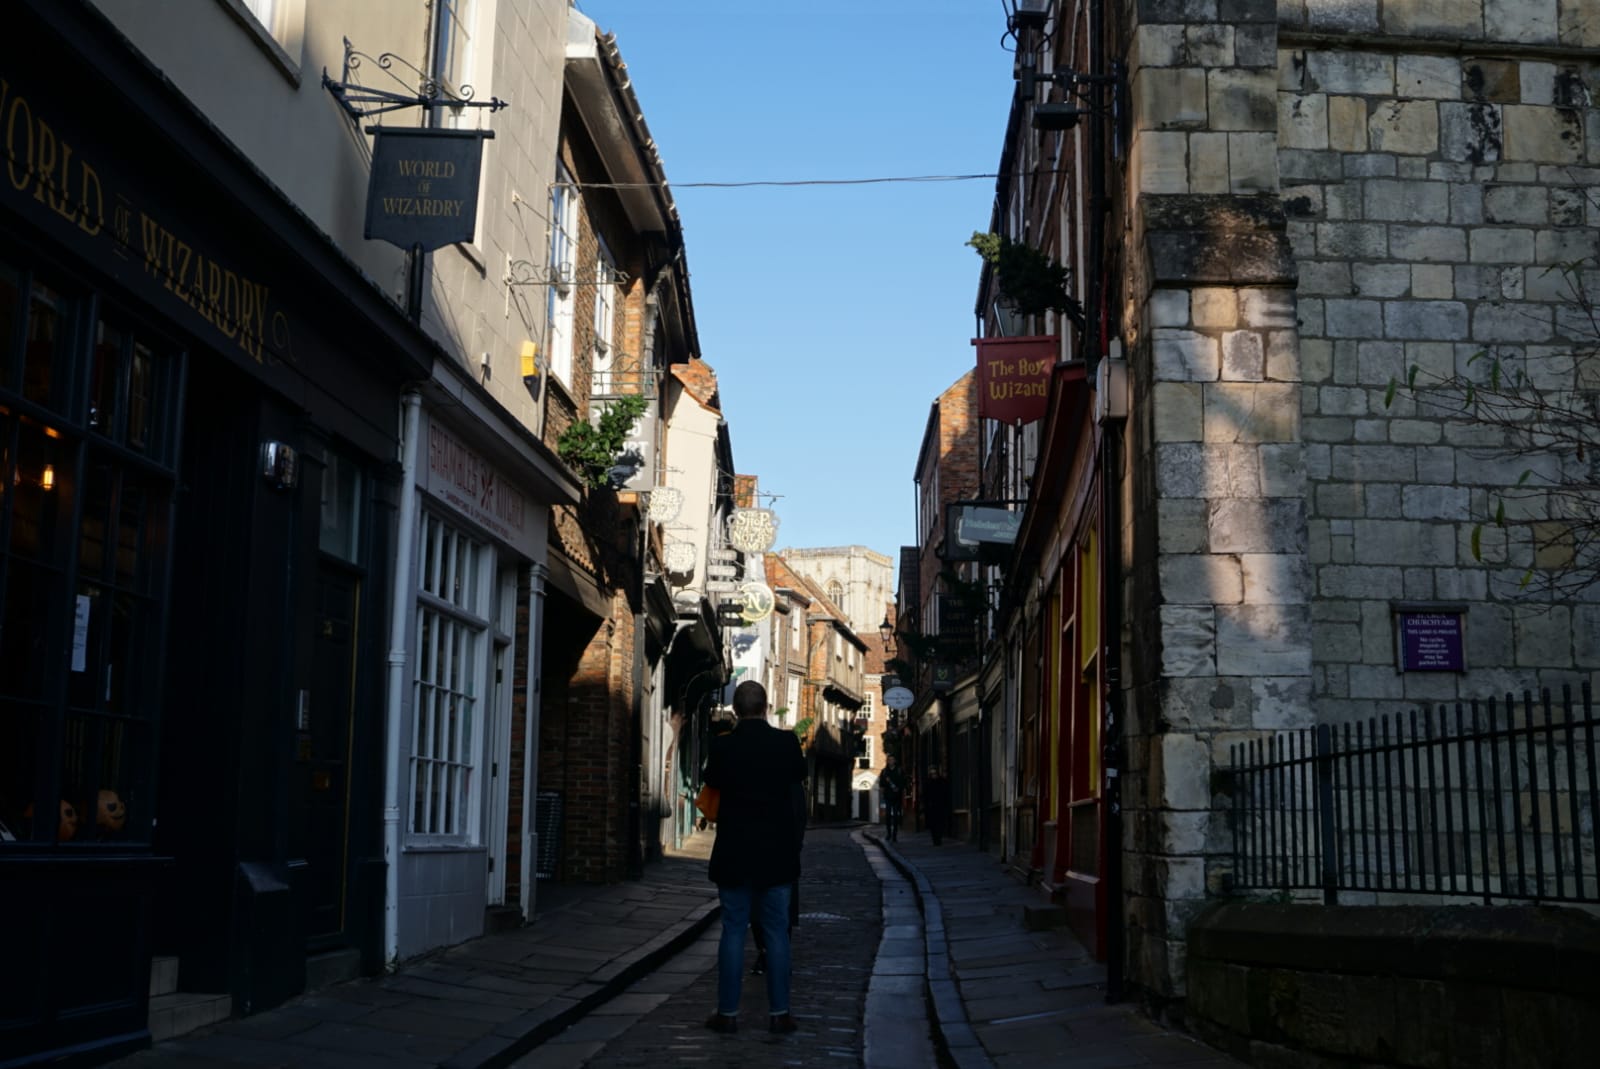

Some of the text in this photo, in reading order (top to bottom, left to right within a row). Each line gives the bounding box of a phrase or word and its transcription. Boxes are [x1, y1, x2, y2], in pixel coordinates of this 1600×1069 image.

[398, 159, 456, 178] WORLD
[417, 181, 432, 194] OF
[383, 198, 464, 217] WIZARDRY
[114, 202, 132, 247] OF
[140, 211, 271, 364] WIZARDRY
[988, 358, 1045, 378] The Boy
[989, 378, 1047, 400] Wizard
[1407, 618, 1456, 626] CHURCHYARD
